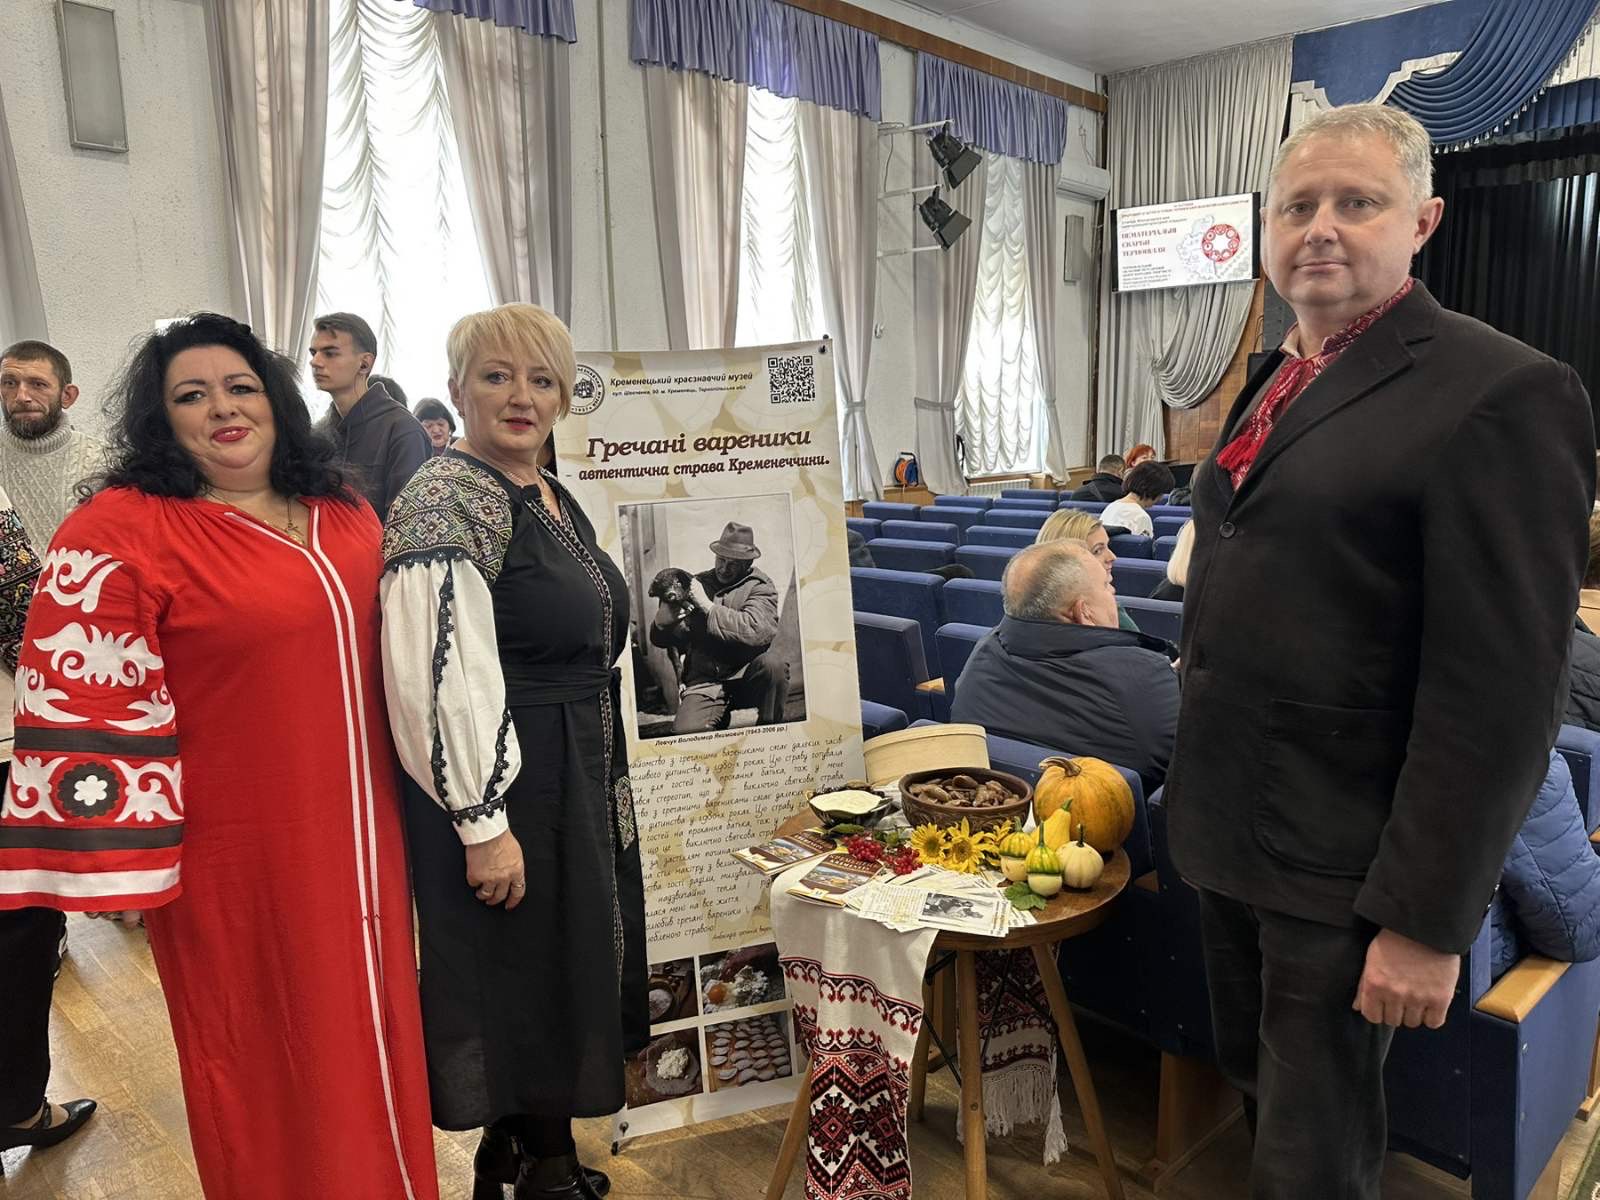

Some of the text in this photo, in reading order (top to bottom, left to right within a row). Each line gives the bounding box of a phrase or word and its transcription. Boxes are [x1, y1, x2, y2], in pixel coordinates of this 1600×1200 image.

[610, 372, 752, 388] Кременецький краєзнавчий музей
[586, 430, 812, 462] Гречані вареники
[578, 466, 670, 480] автентична
[673, 462, 724, 478] страва
[728, 454, 830, 474] Кременеччини.
[678, 735, 714, 744] Володимир
[714, 731, 744, 739] Якимович
[792, 740, 820, 751] далеких
[785, 751, 807, 762] страву
[812, 748, 842, 760] готувала
[672, 778, 694, 788] гостей
[744, 781, 779, 790] виключно
[772, 800, 794, 812] страву
[647, 831, 669, 841] гостей
[703, 898, 713, 907] все
